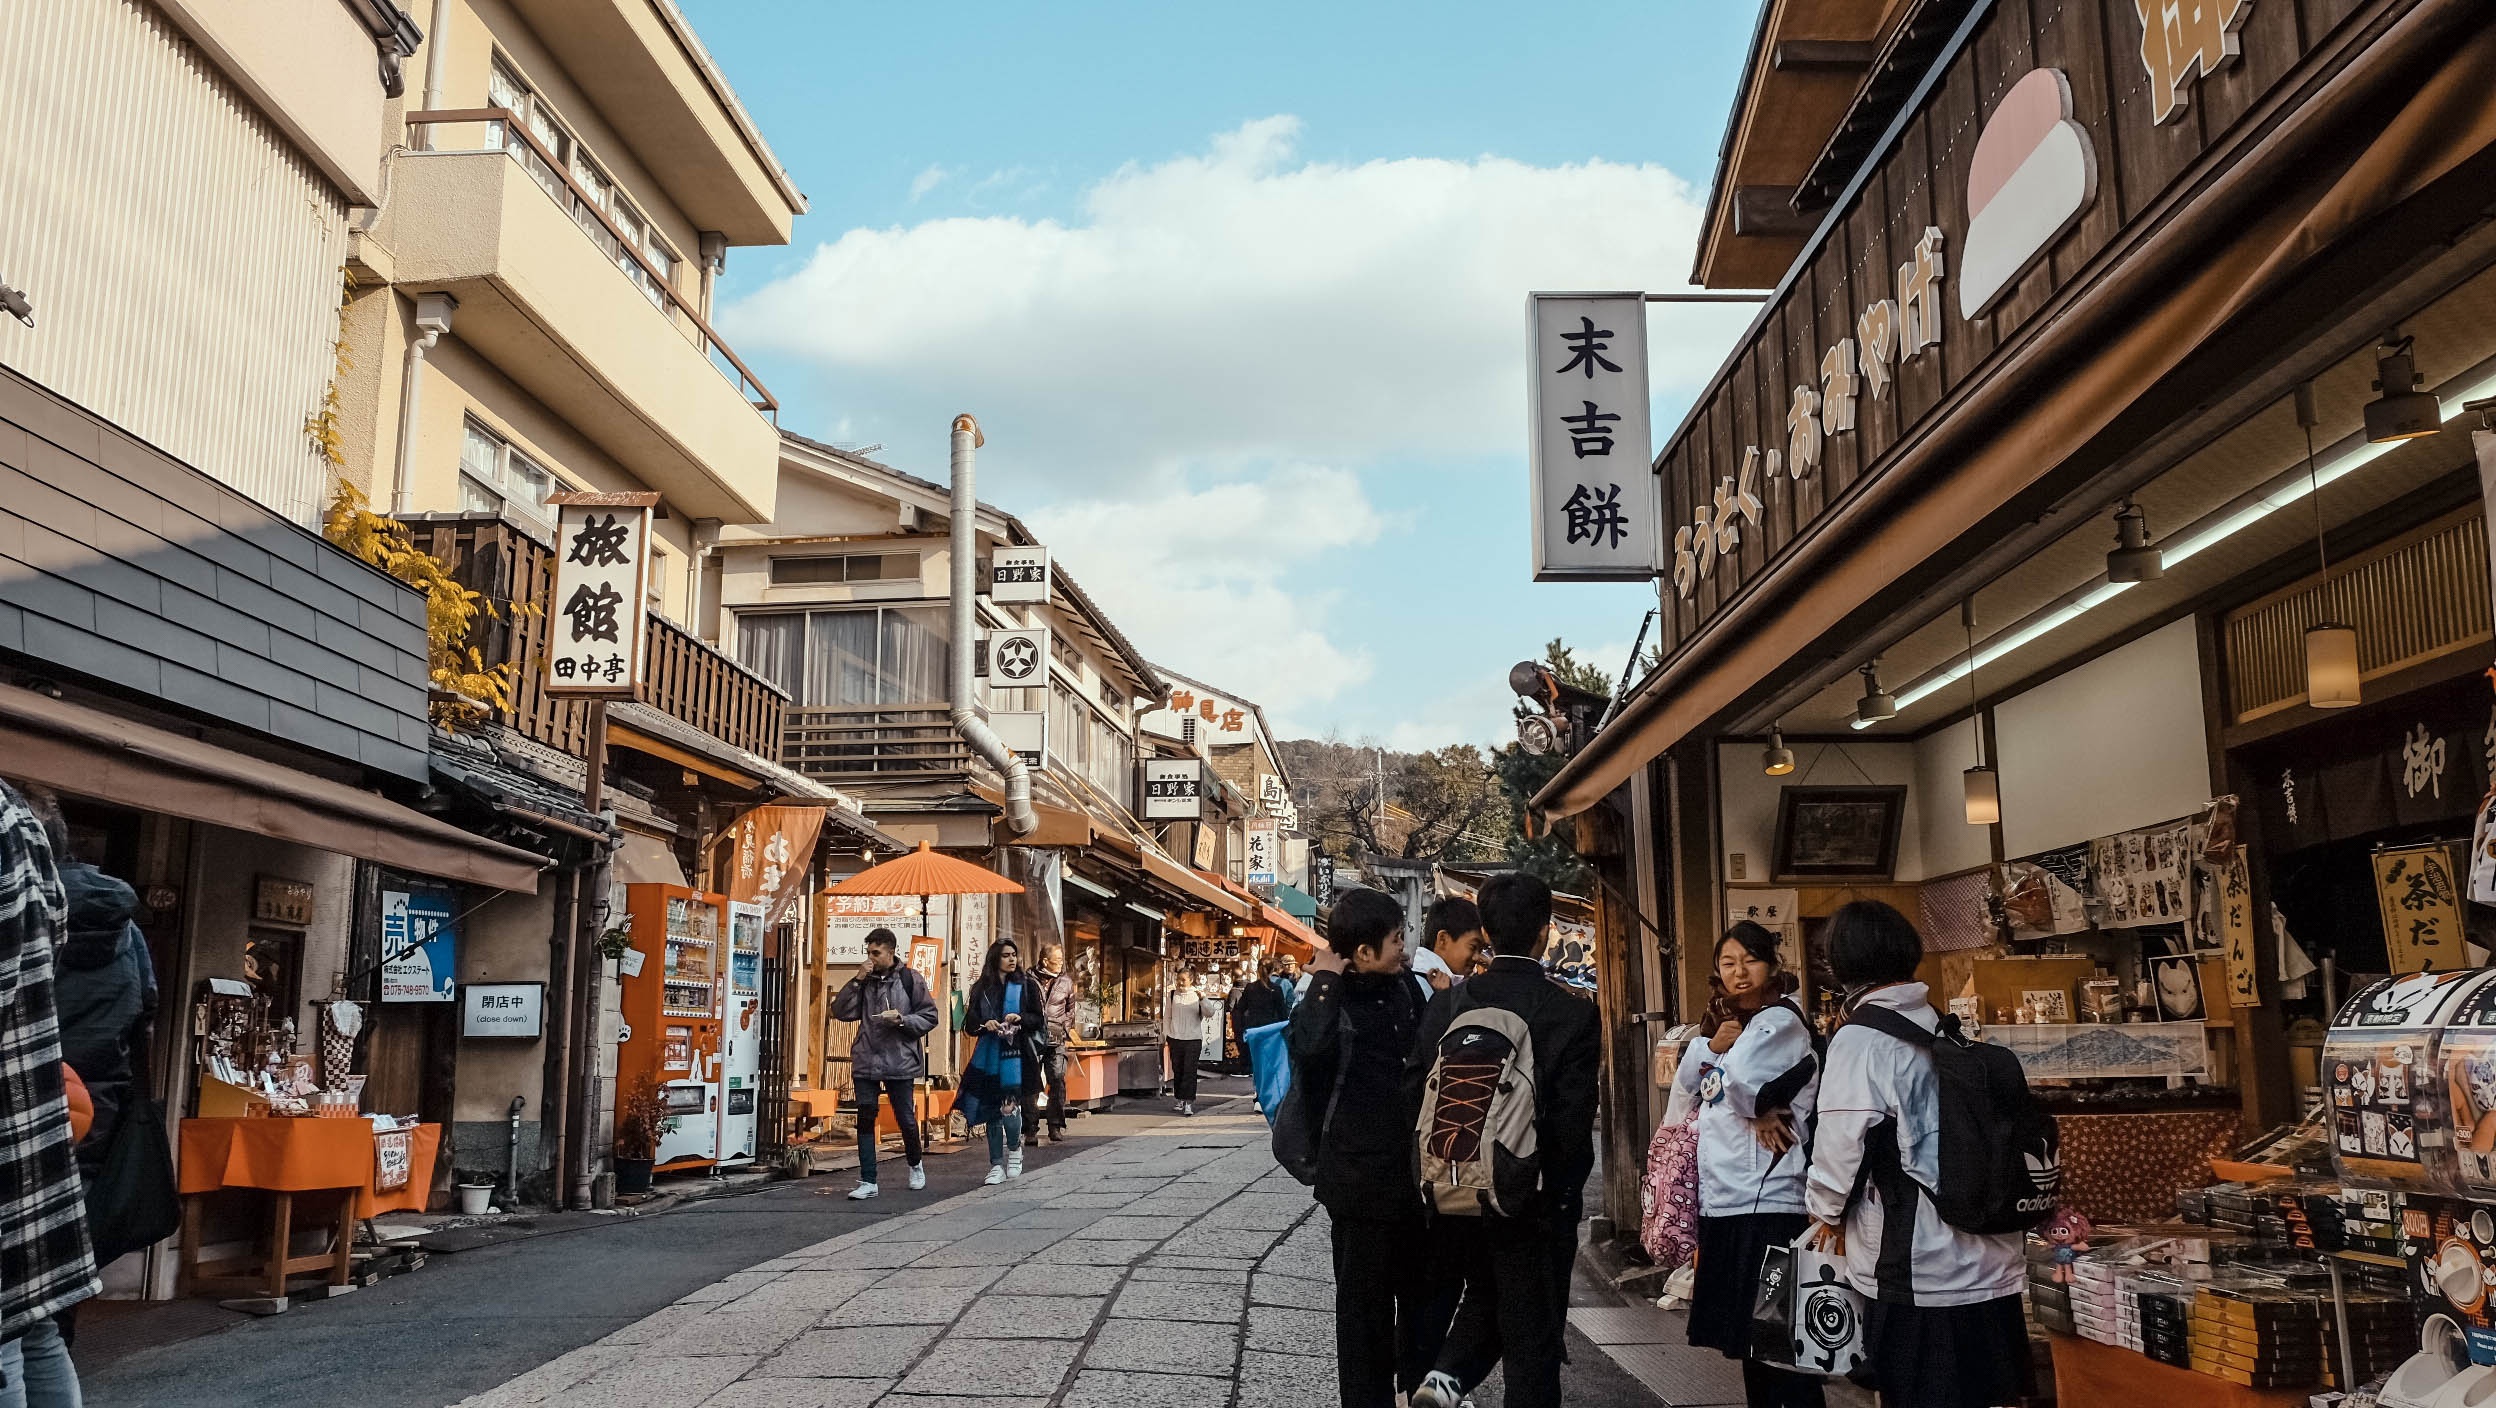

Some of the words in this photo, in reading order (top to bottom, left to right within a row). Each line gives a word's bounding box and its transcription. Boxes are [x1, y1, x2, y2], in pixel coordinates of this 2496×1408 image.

[1556, 316, 1629, 550] 末吉餅
[563, 513, 630, 644] 旅館
[997, 567, 1042, 582] 日野家
[554, 653, 625, 683] 田中亭
[2402, 722, 2446, 799] 御
[1151, 782, 1195, 796] 日野家
[1249, 836, 1264, 871] 花家
[384, 912, 405, 957] 売
[482, 996, 524, 1009] 閉店中
[476, 1015, 501, 1023] (close
[503, 1015, 528, 1023] down)
[2017, 1194, 2057, 1212] adida
[2404, 1213, 2430, 1236] 300円
